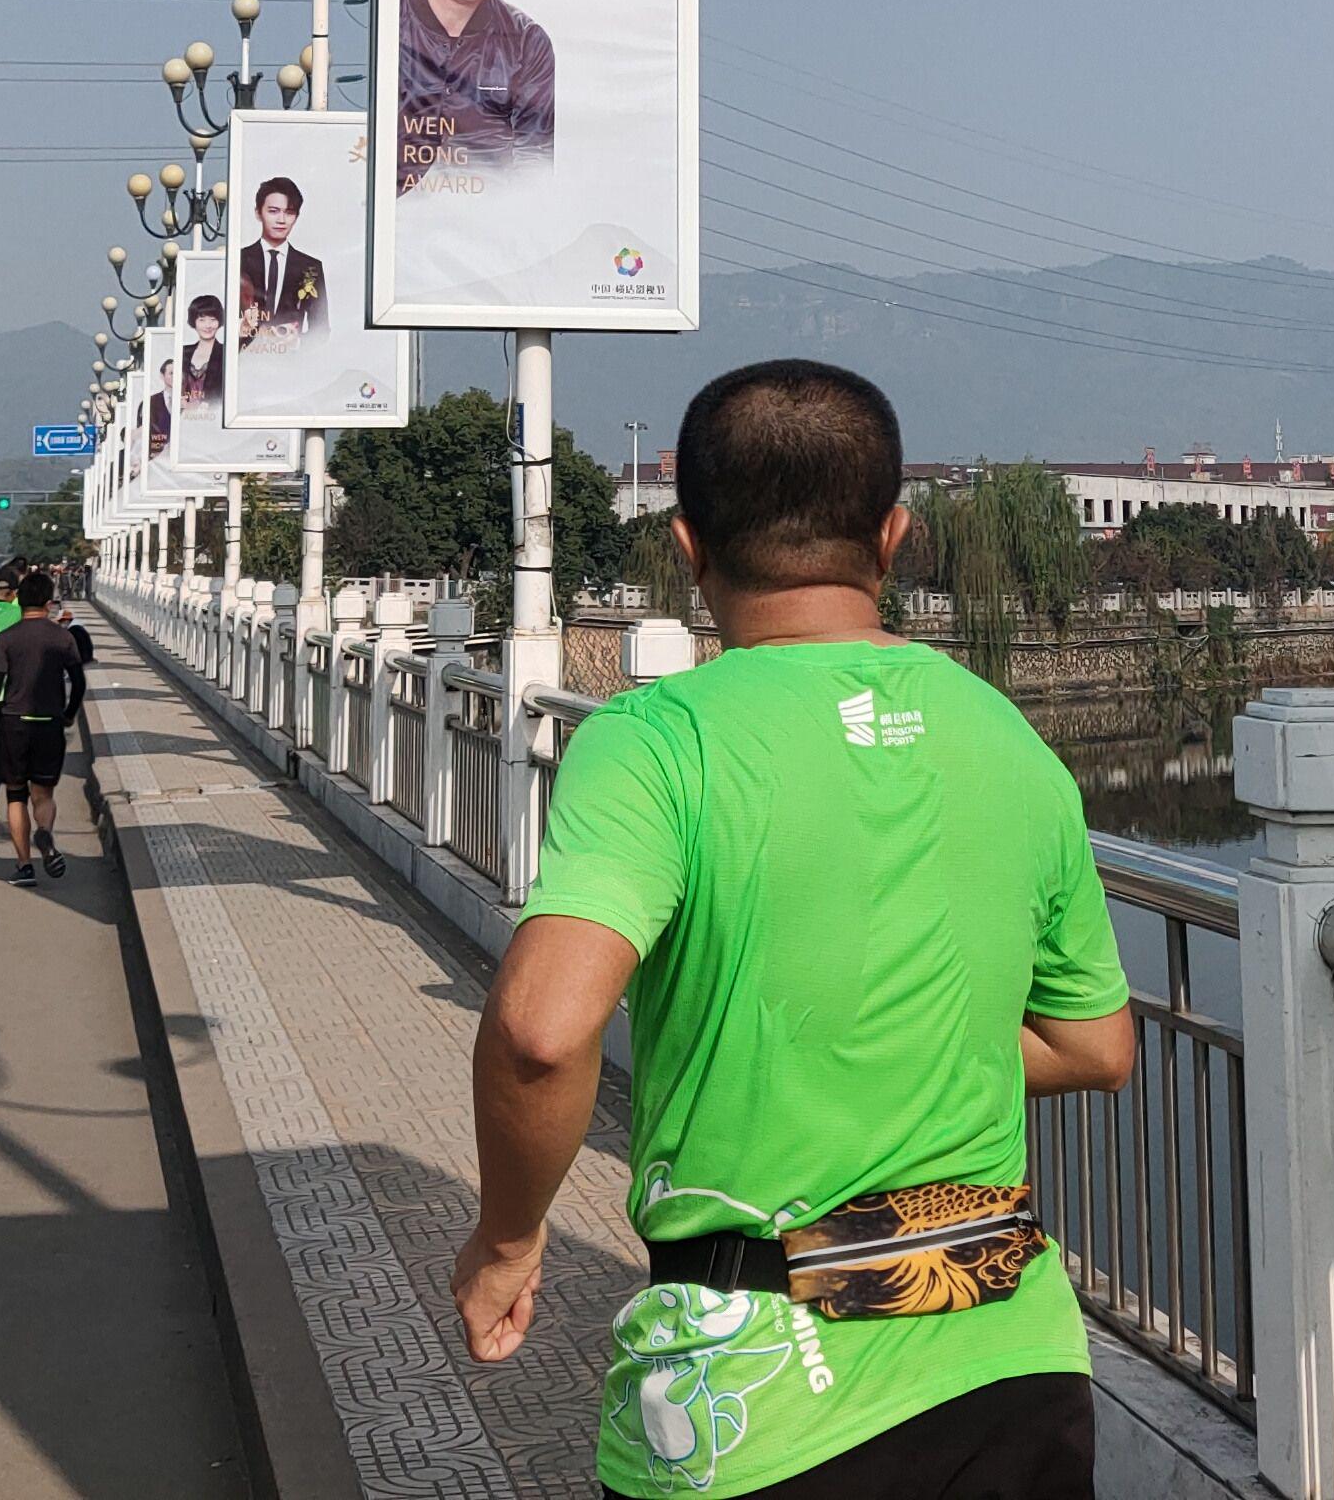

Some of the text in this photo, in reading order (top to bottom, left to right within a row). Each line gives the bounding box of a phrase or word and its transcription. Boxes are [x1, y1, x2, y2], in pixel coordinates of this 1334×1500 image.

[402, 115, 456, 136] WEN
[402, 144, 469, 166] RONG
[401, 173, 485, 195] AWARD
